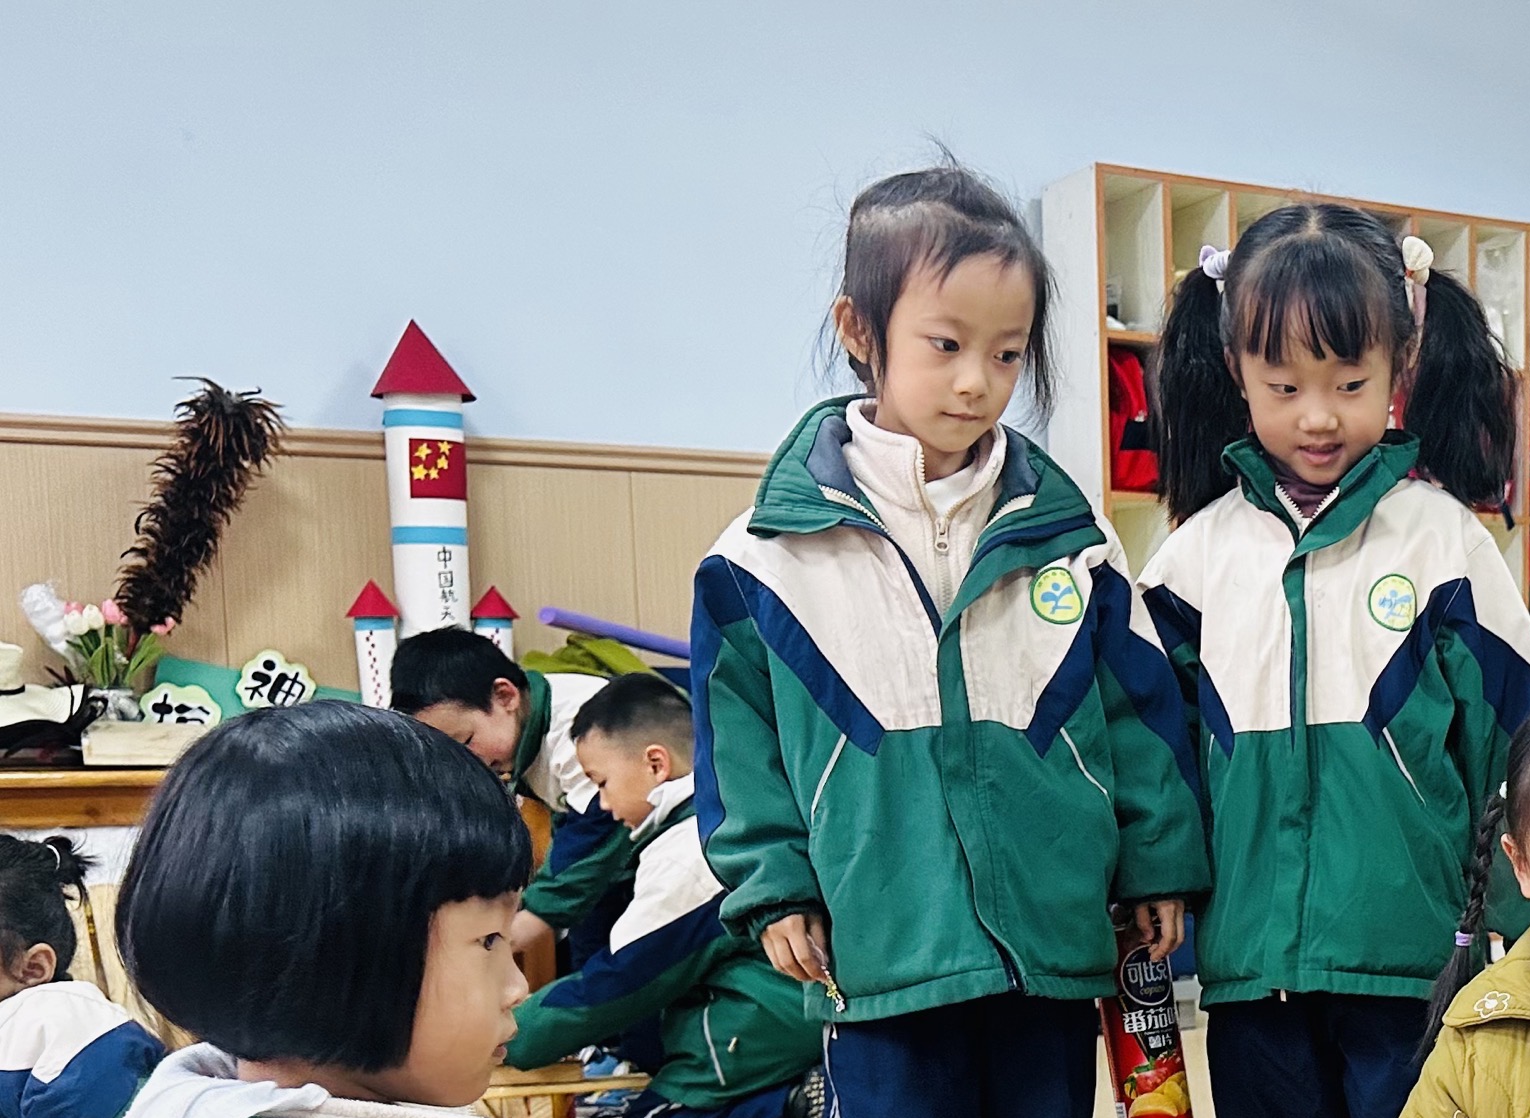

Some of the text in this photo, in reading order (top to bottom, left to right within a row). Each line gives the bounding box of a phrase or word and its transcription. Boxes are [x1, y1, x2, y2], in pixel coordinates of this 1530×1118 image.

[437, 545, 458, 621] 中国航天
[1148, 1033, 1173, 1049] 薯片
